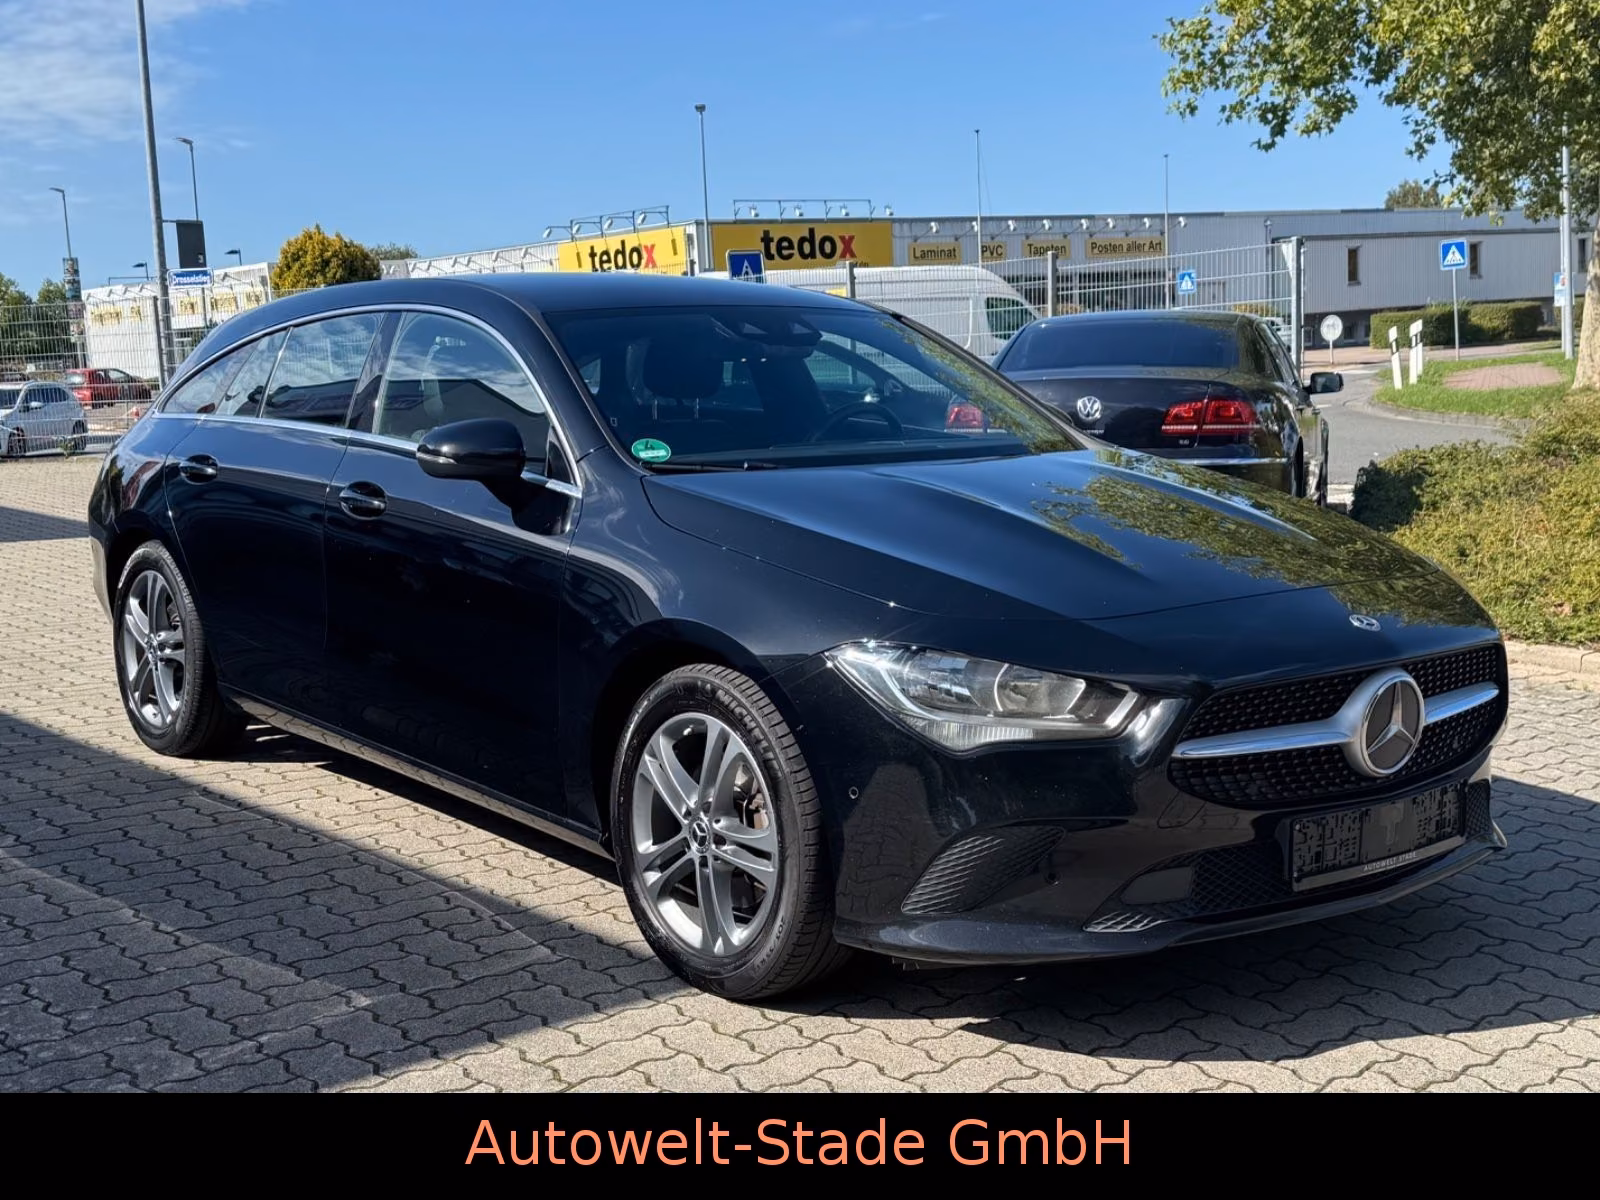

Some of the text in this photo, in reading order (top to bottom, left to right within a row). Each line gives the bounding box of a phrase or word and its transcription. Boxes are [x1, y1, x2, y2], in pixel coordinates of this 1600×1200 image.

[760, 227, 857, 261] tedox
[912, 245, 957, 260] Laminat
[981, 244, 1003, 257] PVC
[1027, 243, 1067, 257] Tapeten
[1091, 240, 1162, 254] Posten aller Art
[589, 239, 658, 272] tedox
[716, 688, 783, 779] MICHELIN
[1364, 851, 1417, 872] AUTOWELT STADE
